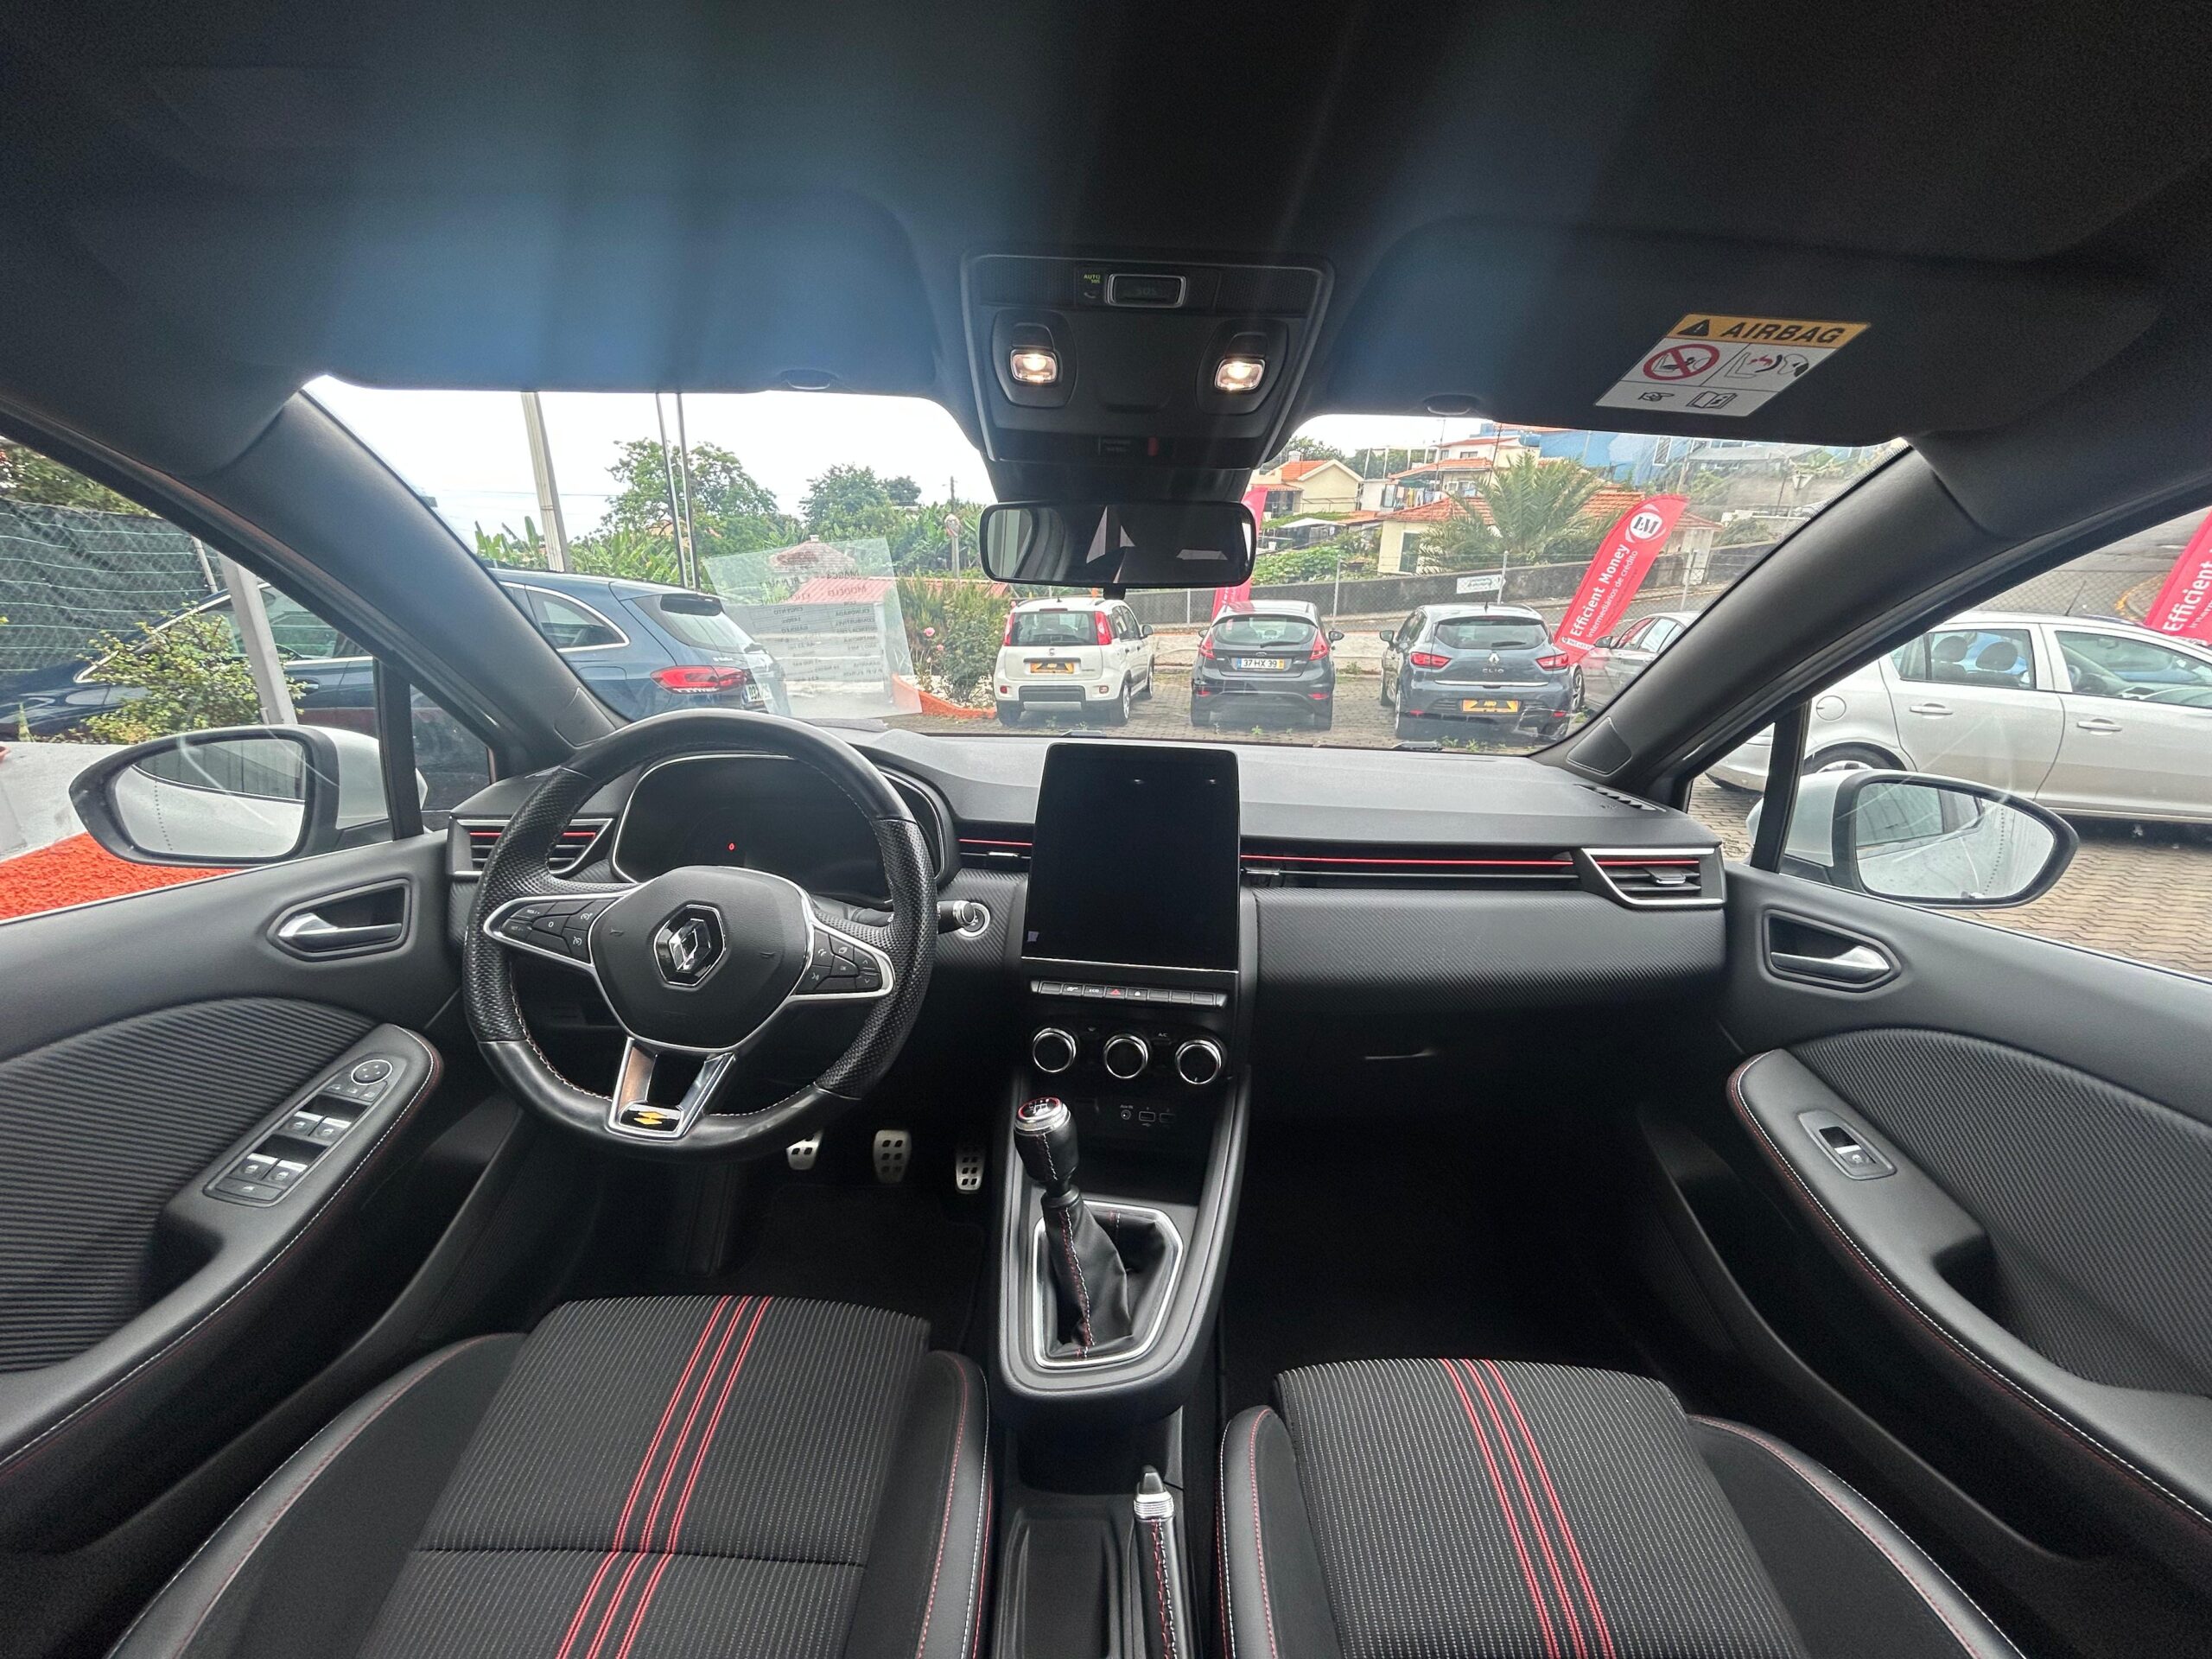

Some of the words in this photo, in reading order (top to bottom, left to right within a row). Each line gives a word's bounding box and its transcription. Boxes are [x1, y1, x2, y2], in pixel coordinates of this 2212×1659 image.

[1720, 321, 1847, 344] AIRBAG
[1615, 576, 1624, 587] de
[1620, 550, 1638, 576] crédito
[1569, 587, 1605, 637] Efficient
[1599, 543, 1631, 585] Money
[1268, 659, 1276, 668] 39
